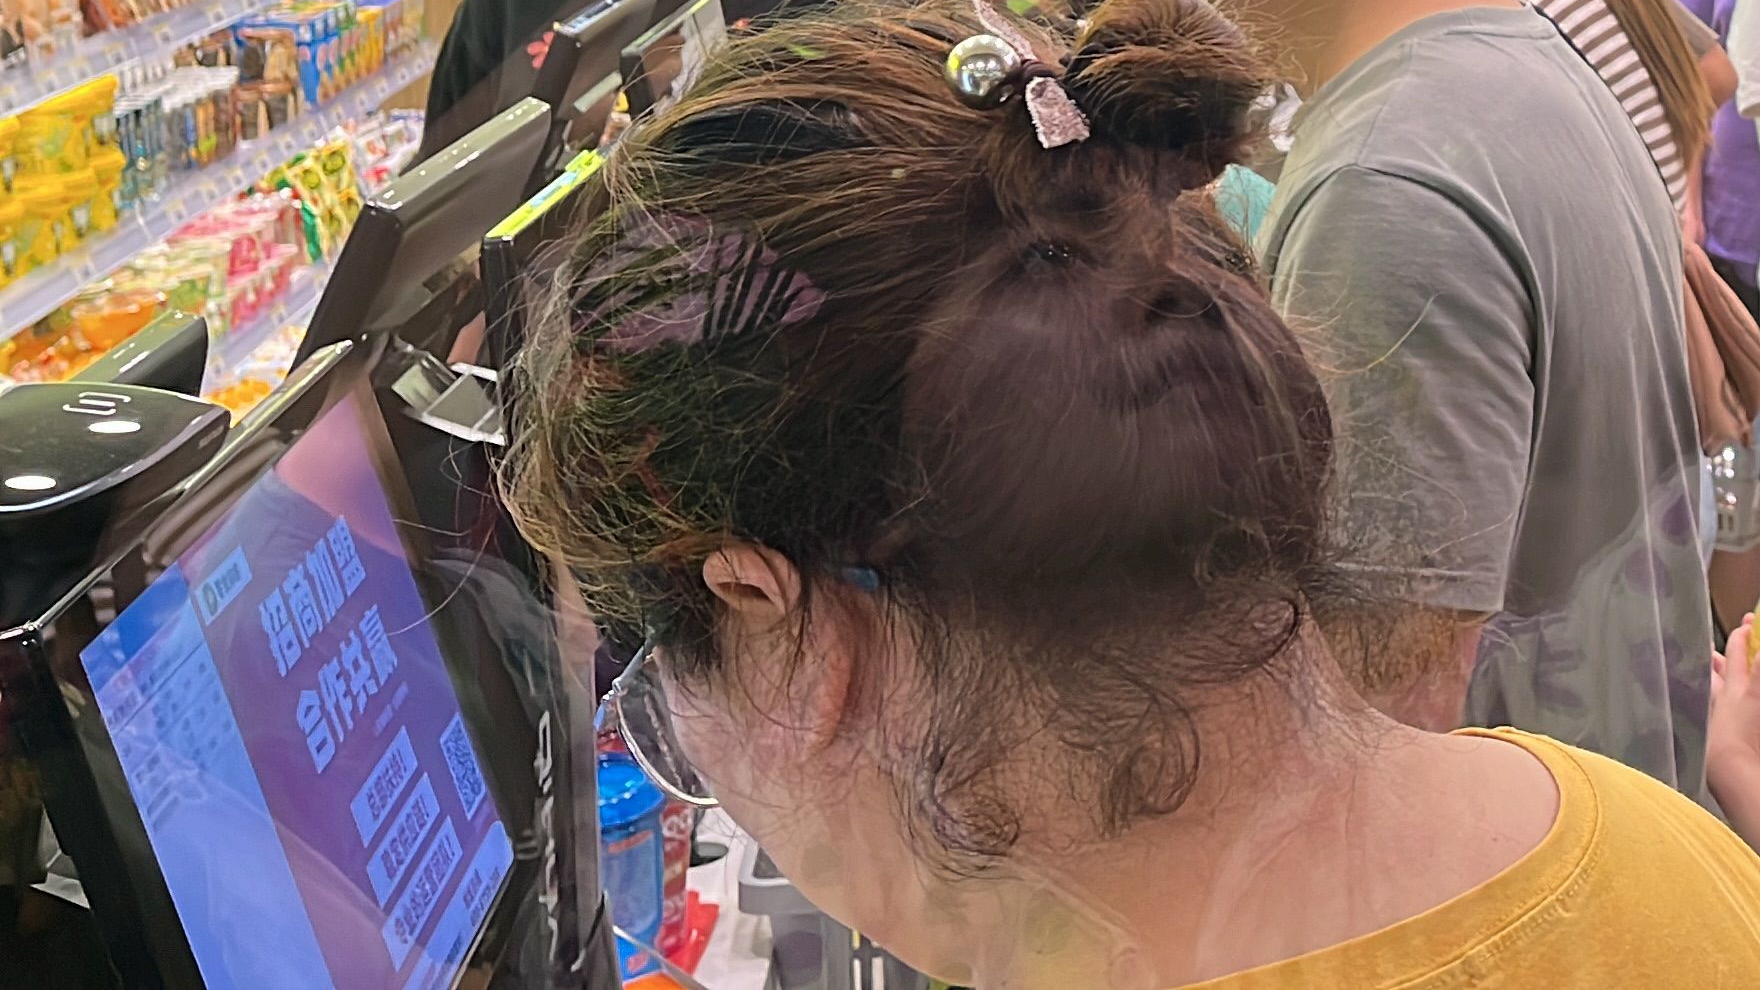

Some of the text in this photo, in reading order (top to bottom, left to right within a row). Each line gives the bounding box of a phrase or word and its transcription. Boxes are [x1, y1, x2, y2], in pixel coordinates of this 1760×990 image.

[259, 515, 366, 677] 招商加盟
[296, 604, 397, 774] 合作共赢
